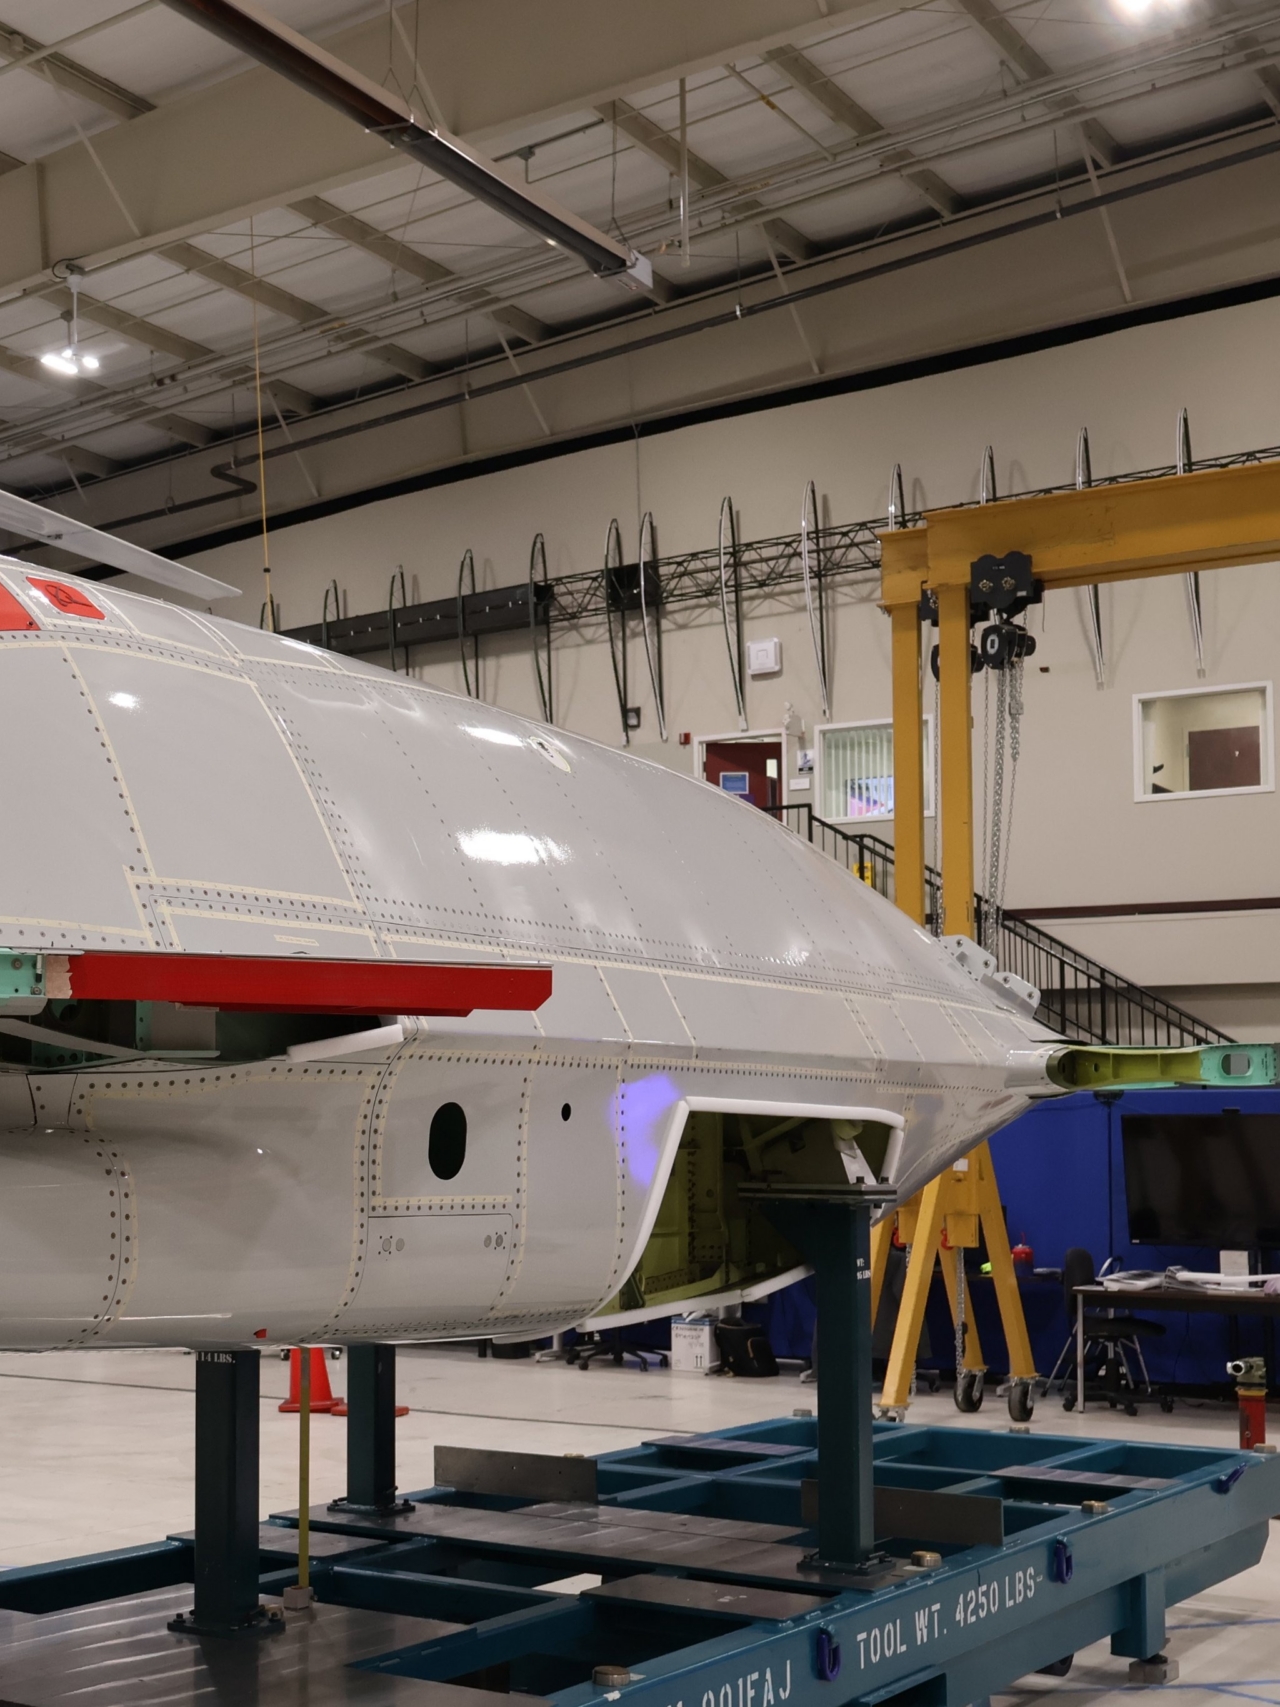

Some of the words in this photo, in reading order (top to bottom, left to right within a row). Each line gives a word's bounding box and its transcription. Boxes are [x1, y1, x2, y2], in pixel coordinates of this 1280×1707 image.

[856, 1618, 907, 1669] TOOL
[914, 1603, 947, 1646] WT.
[955, 1581, 999, 1628] 4250
